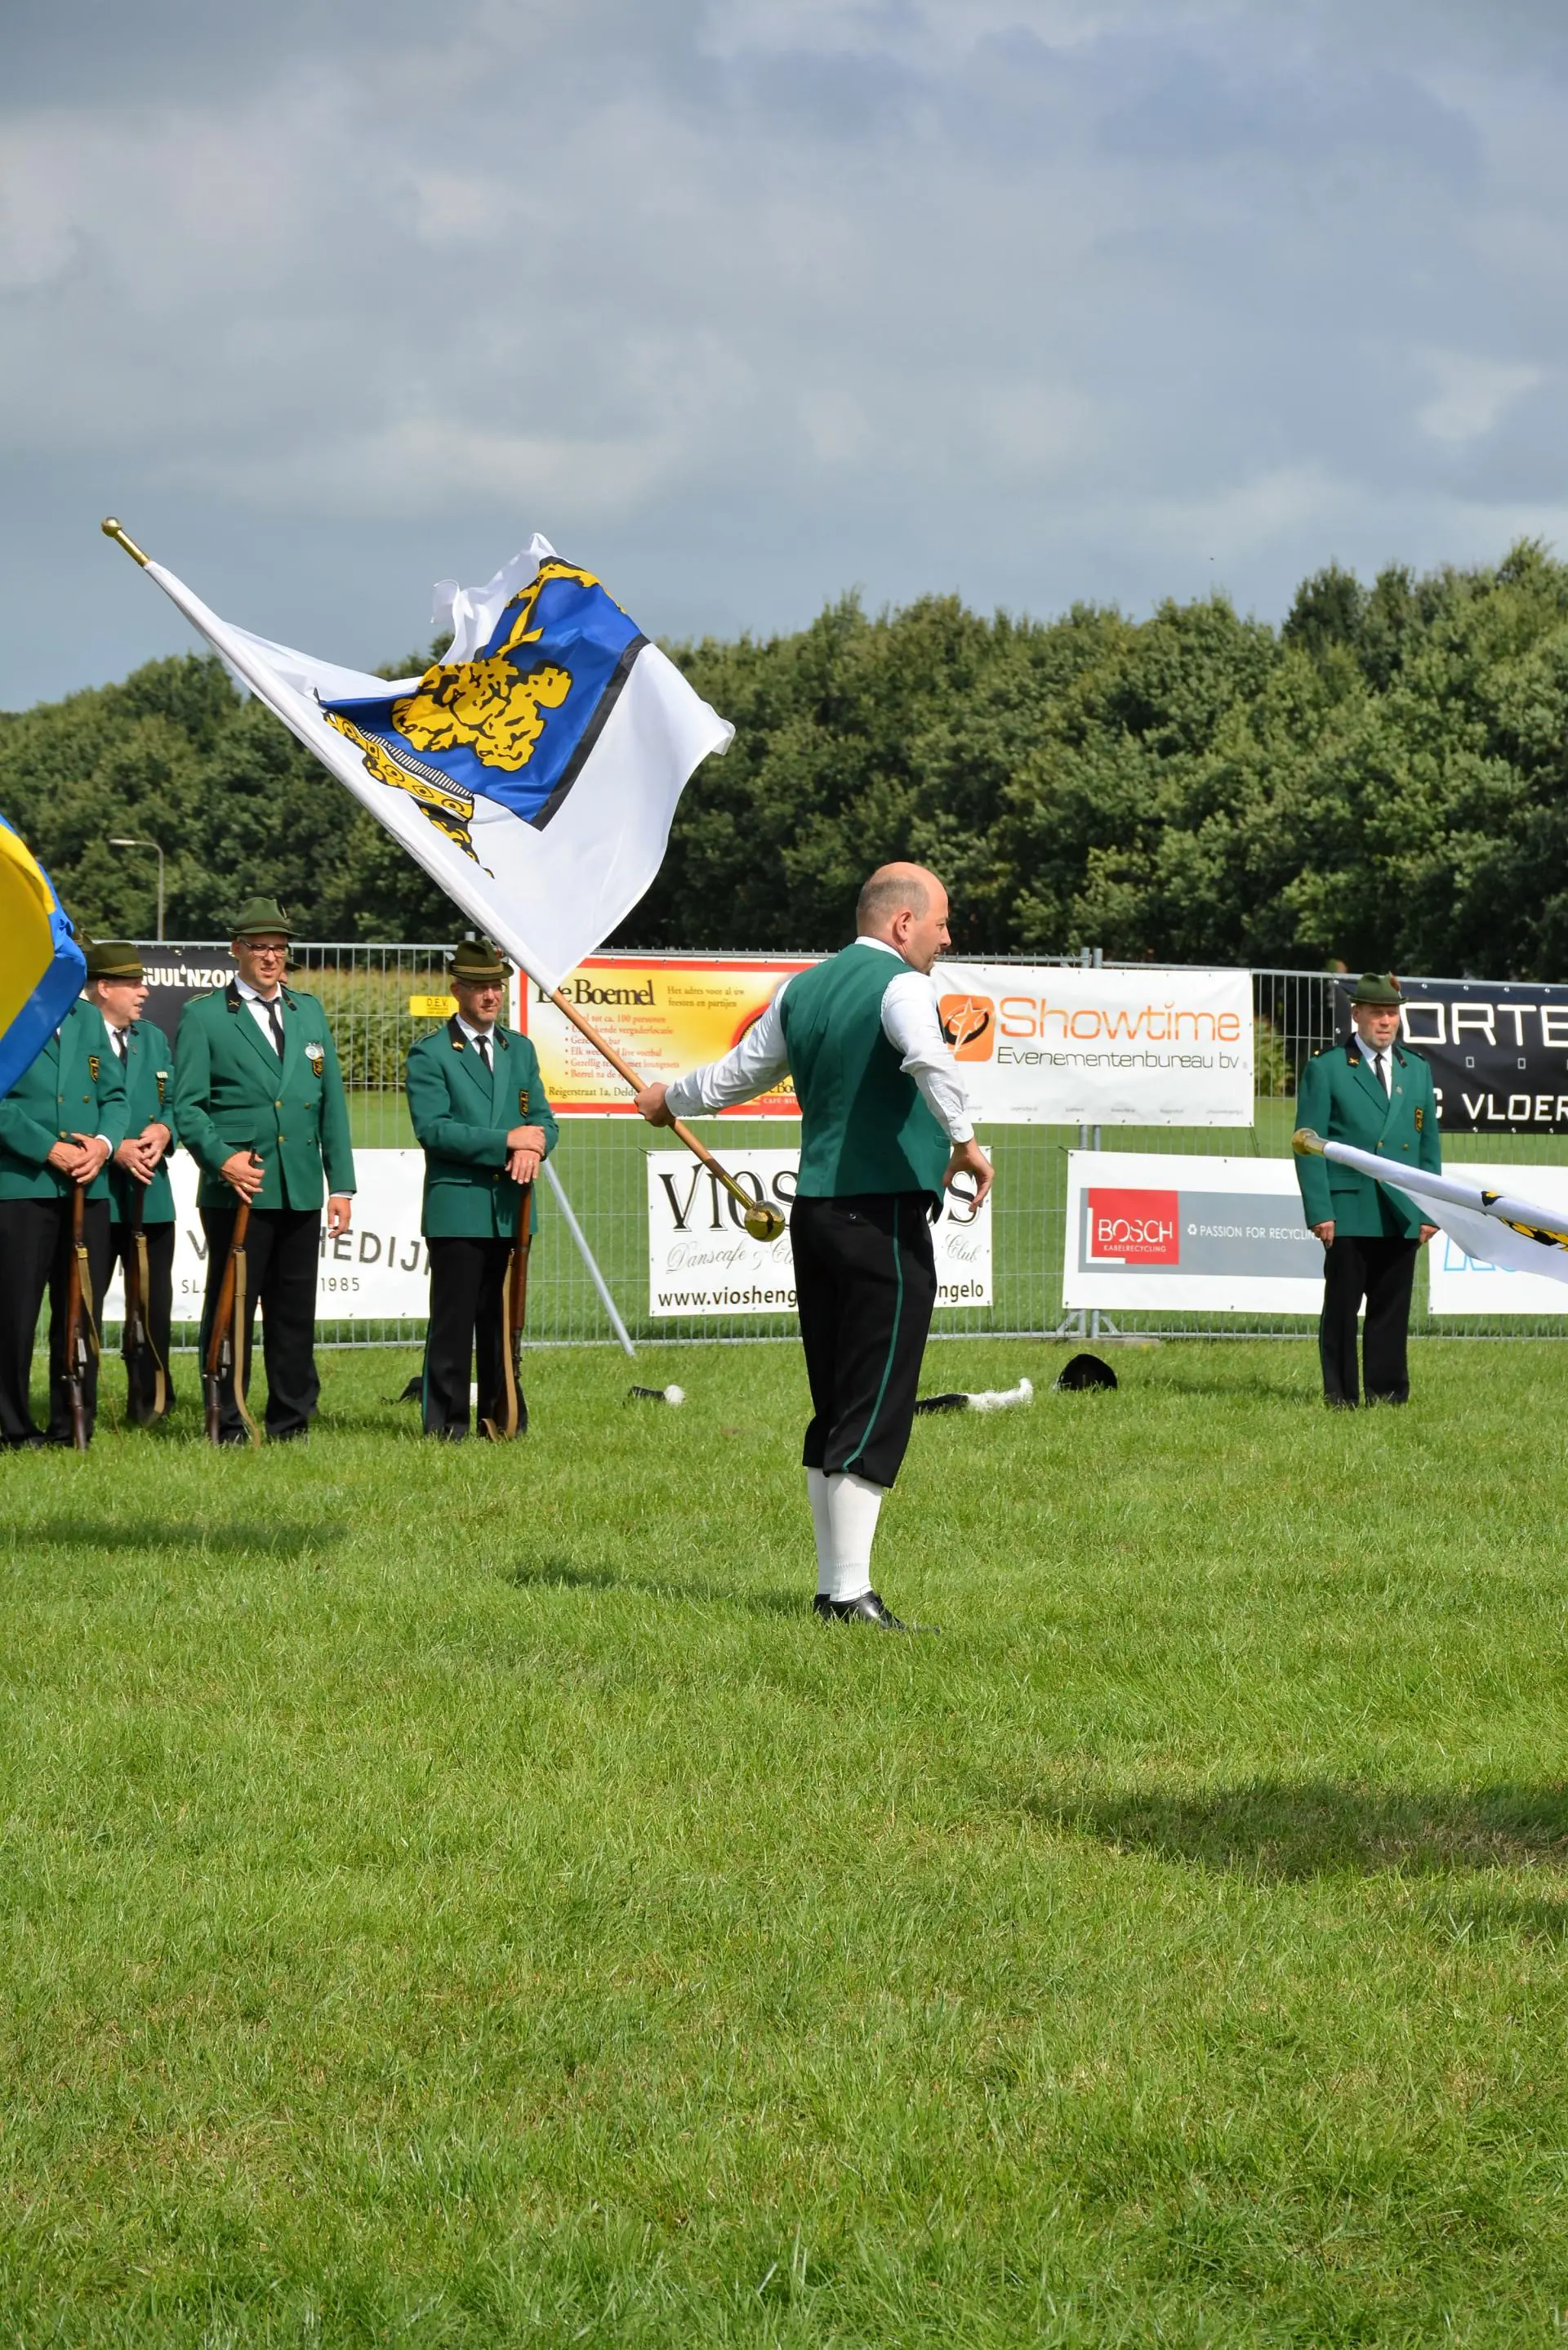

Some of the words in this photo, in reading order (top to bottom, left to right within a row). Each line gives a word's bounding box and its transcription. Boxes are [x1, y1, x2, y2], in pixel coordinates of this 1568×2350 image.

[573, 979, 656, 1006] Boemel
[667, 986, 681, 994] Het
[684, 986, 703, 995] adres
[706, 988, 722, 996] voor
[668, 997, 694, 1006] feesten
[708, 998, 737, 1010] partijen
[1000, 997, 1240, 1041] Showtime
[1352, 1002, 1568, 1047] ORTE
[997, 1046, 1214, 1069] Evenementenbureau
[1219, 1052, 1239, 1069] bv
[549, 1087, 596, 1098] Reigerstraat
[1098, 1219, 1173, 1242] BOSCH
[1200, 1225, 1242, 1237] PASSION
[1246, 1227, 1266, 1238] FOR
[1269, 1229, 1321, 1241] RECYCLIN
[1103, 1244, 1167, 1253] KABELRECYCLING
[321, 1277, 359, 1292] 1985
[658, 1285, 797, 1307] www.viosheng
[938, 1279, 983, 1302] ngelo
